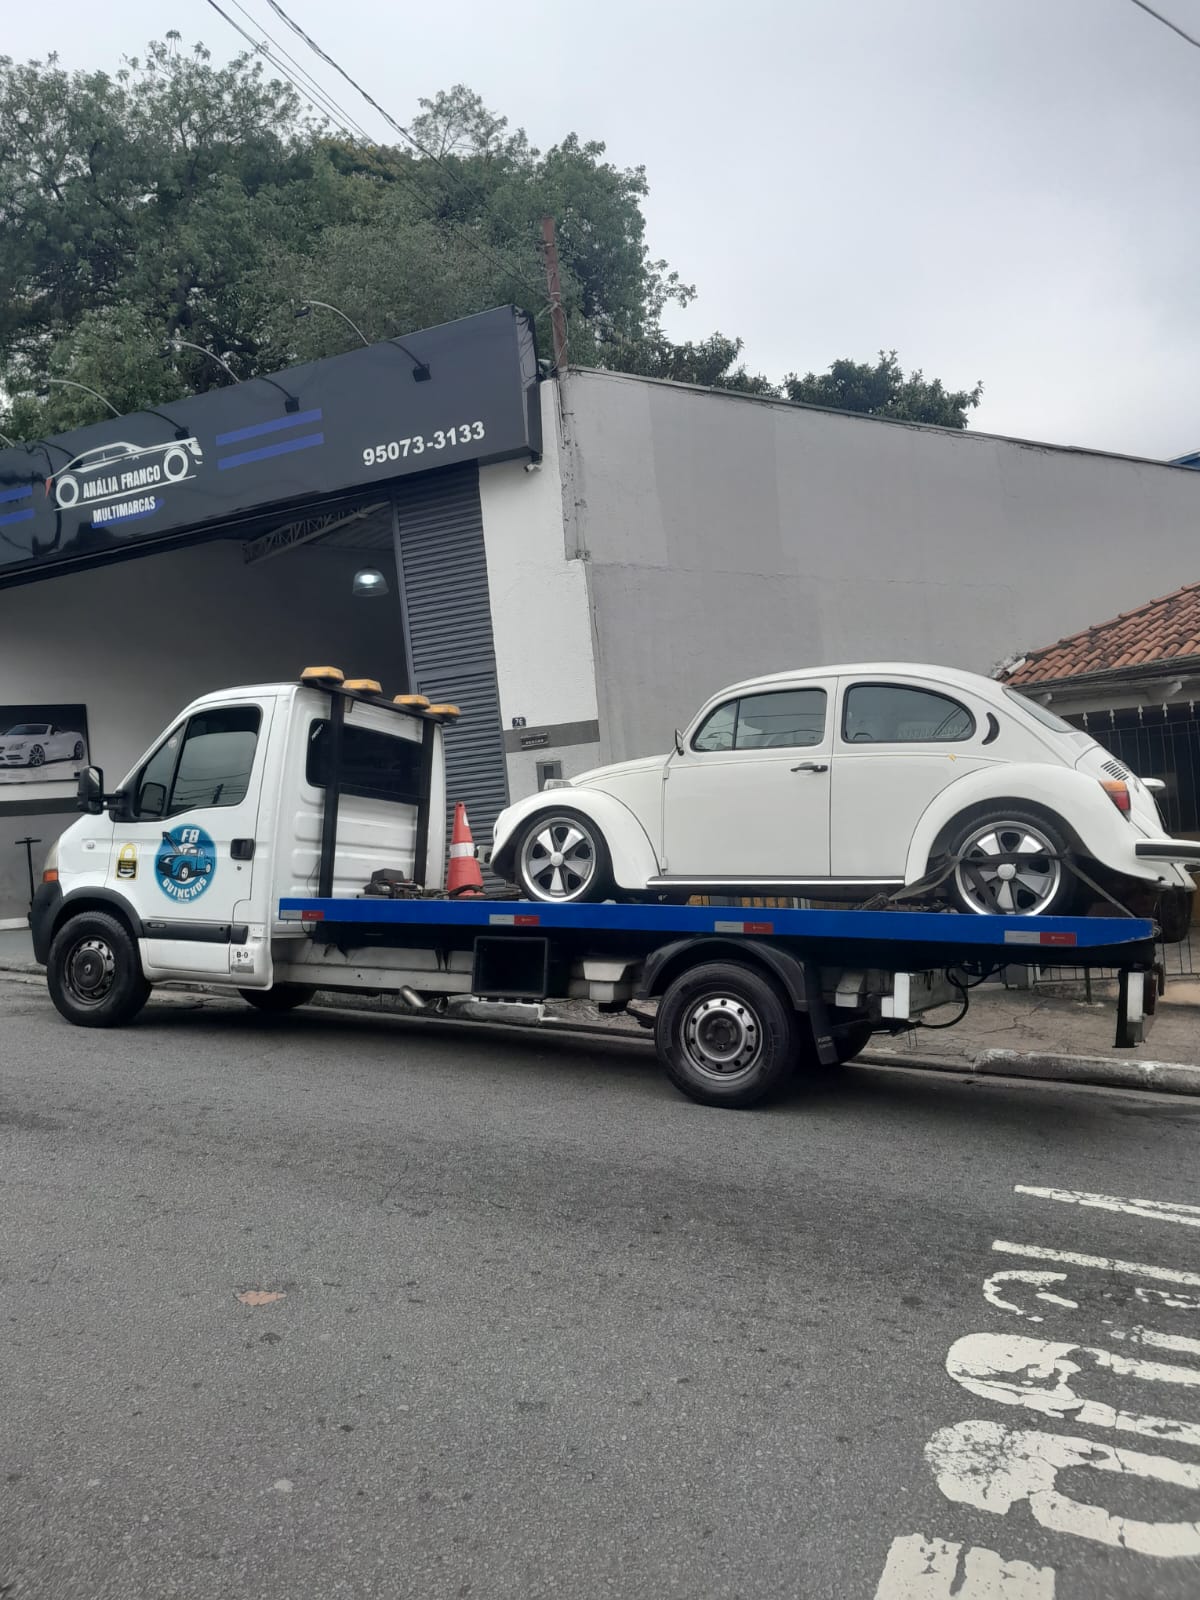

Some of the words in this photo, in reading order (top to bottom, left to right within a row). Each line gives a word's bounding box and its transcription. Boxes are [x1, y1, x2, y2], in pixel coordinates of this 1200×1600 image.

[362, 421, 485, 466] 95073-3133
[83, 475, 119, 499] ANÁLIA
[120, 464, 161, 490] FRANCO
[92, 496, 156, 523] MULTIMARCAS
[181, 828, 200, 843] FB
[162, 876, 208, 899] GUINCHOS
